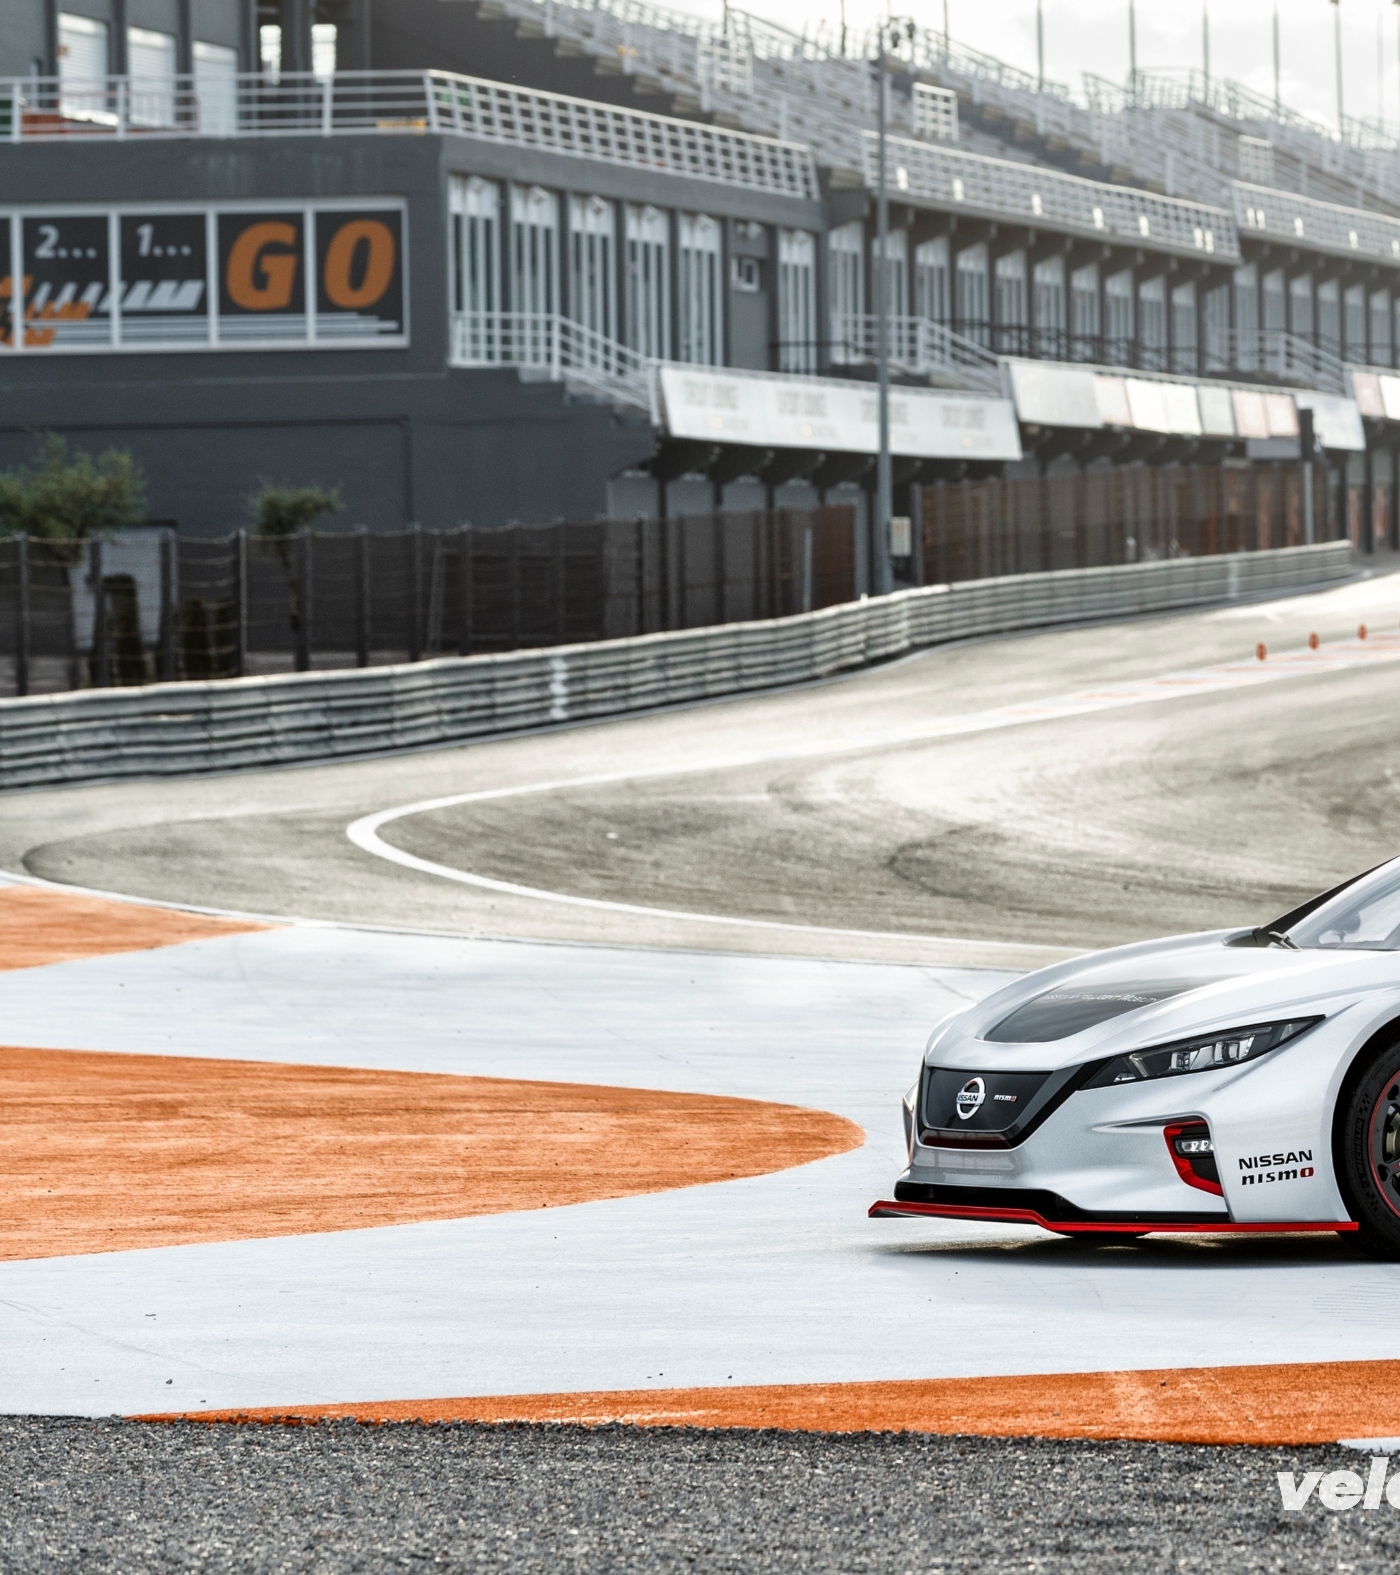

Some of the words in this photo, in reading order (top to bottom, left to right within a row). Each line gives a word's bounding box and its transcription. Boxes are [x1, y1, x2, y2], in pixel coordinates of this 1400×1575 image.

[35, 224, 97, 259] 2...
[137, 223, 191, 256] 1...
[226, 219, 396, 311] GO
[958, 1094, 979, 1102] ISSAN
[1239, 1149, 1312, 1170] NISSAN
[1242, 1167, 1314, 1185] nismo
